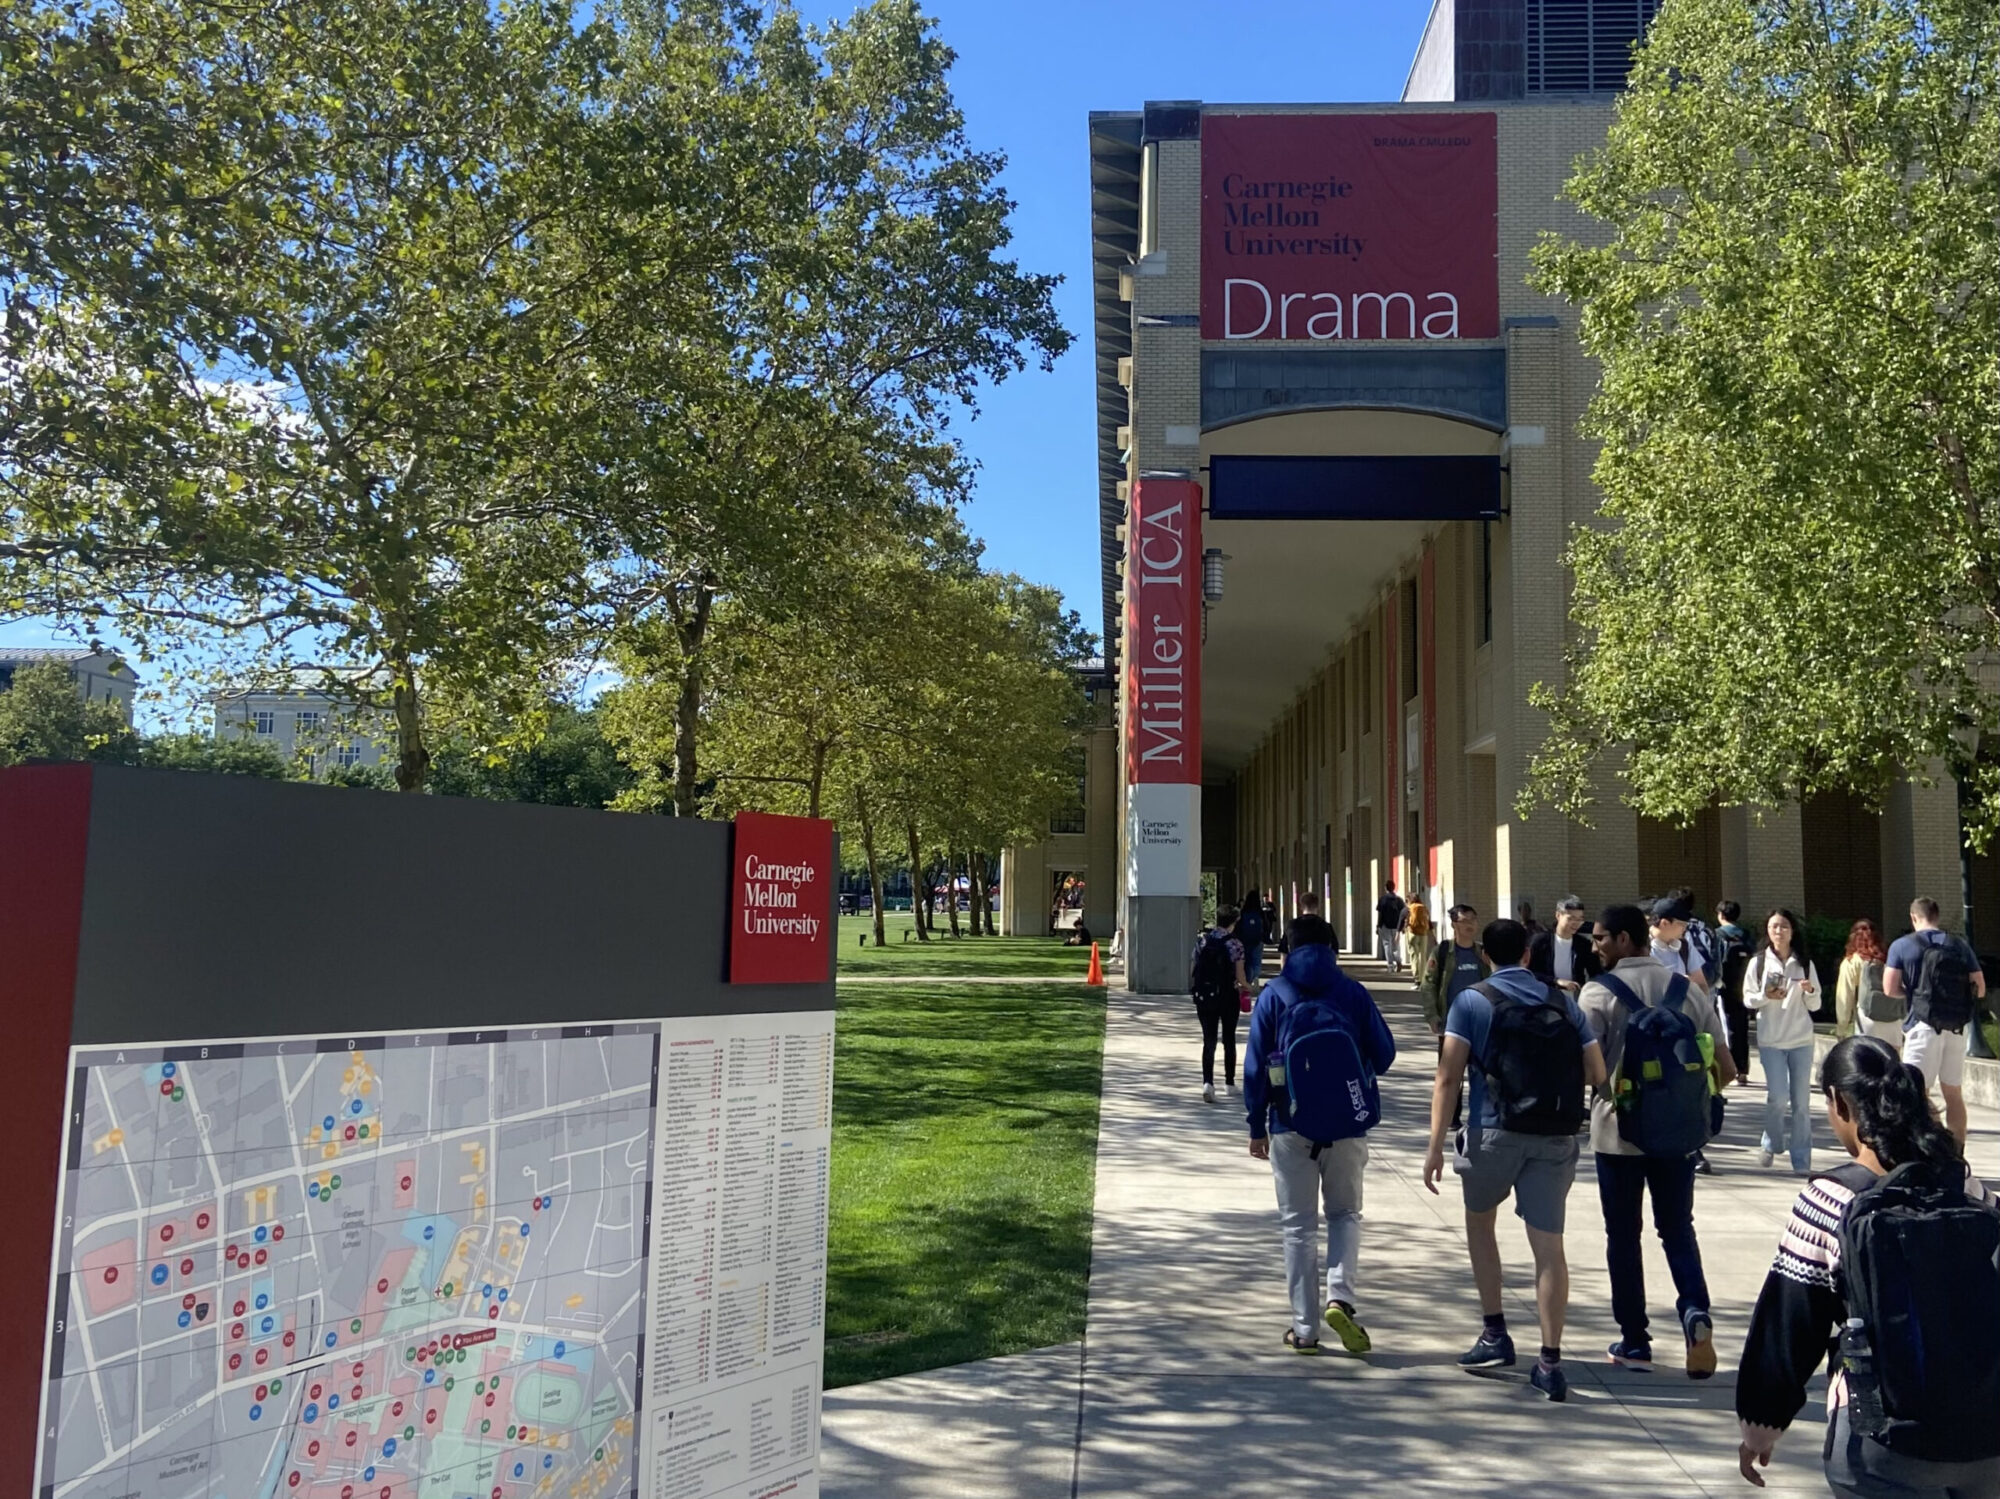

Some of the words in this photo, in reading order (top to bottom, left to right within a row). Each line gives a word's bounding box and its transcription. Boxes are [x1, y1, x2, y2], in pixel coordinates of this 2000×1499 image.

[1222, 174, 1353, 204] Carnegie
[1222, 202, 1320, 228] Mellon
[1223, 231, 1367, 260] University
[1223, 278, 1460, 340] Drama
[1141, 500, 1184, 588] ICA
[1141, 614, 1184, 765] Miller
[1142, 819, 1178, 829] Carnegie
[1142, 828, 1169, 836] Mellon
[1142, 837, 1182, 846] University
[745, 854, 815, 890] Carnegie
[744, 882, 798, 908] Mellon
[743, 909, 821, 942] University
[115, 1052, 126, 1064] A
[201, 1047, 208, 1059] B
[348, 1039, 356, 1050] D
[414, 1036, 420, 1046] E
[475, 1033, 481, 1042] F
[585, 1027, 591, 1036] H
[1346, 1079, 1362, 1110] CREST
[64, 1215, 72, 1227] 2
[55, 1320, 64, 1333] 3
[47, 1427, 55, 1438] 4
